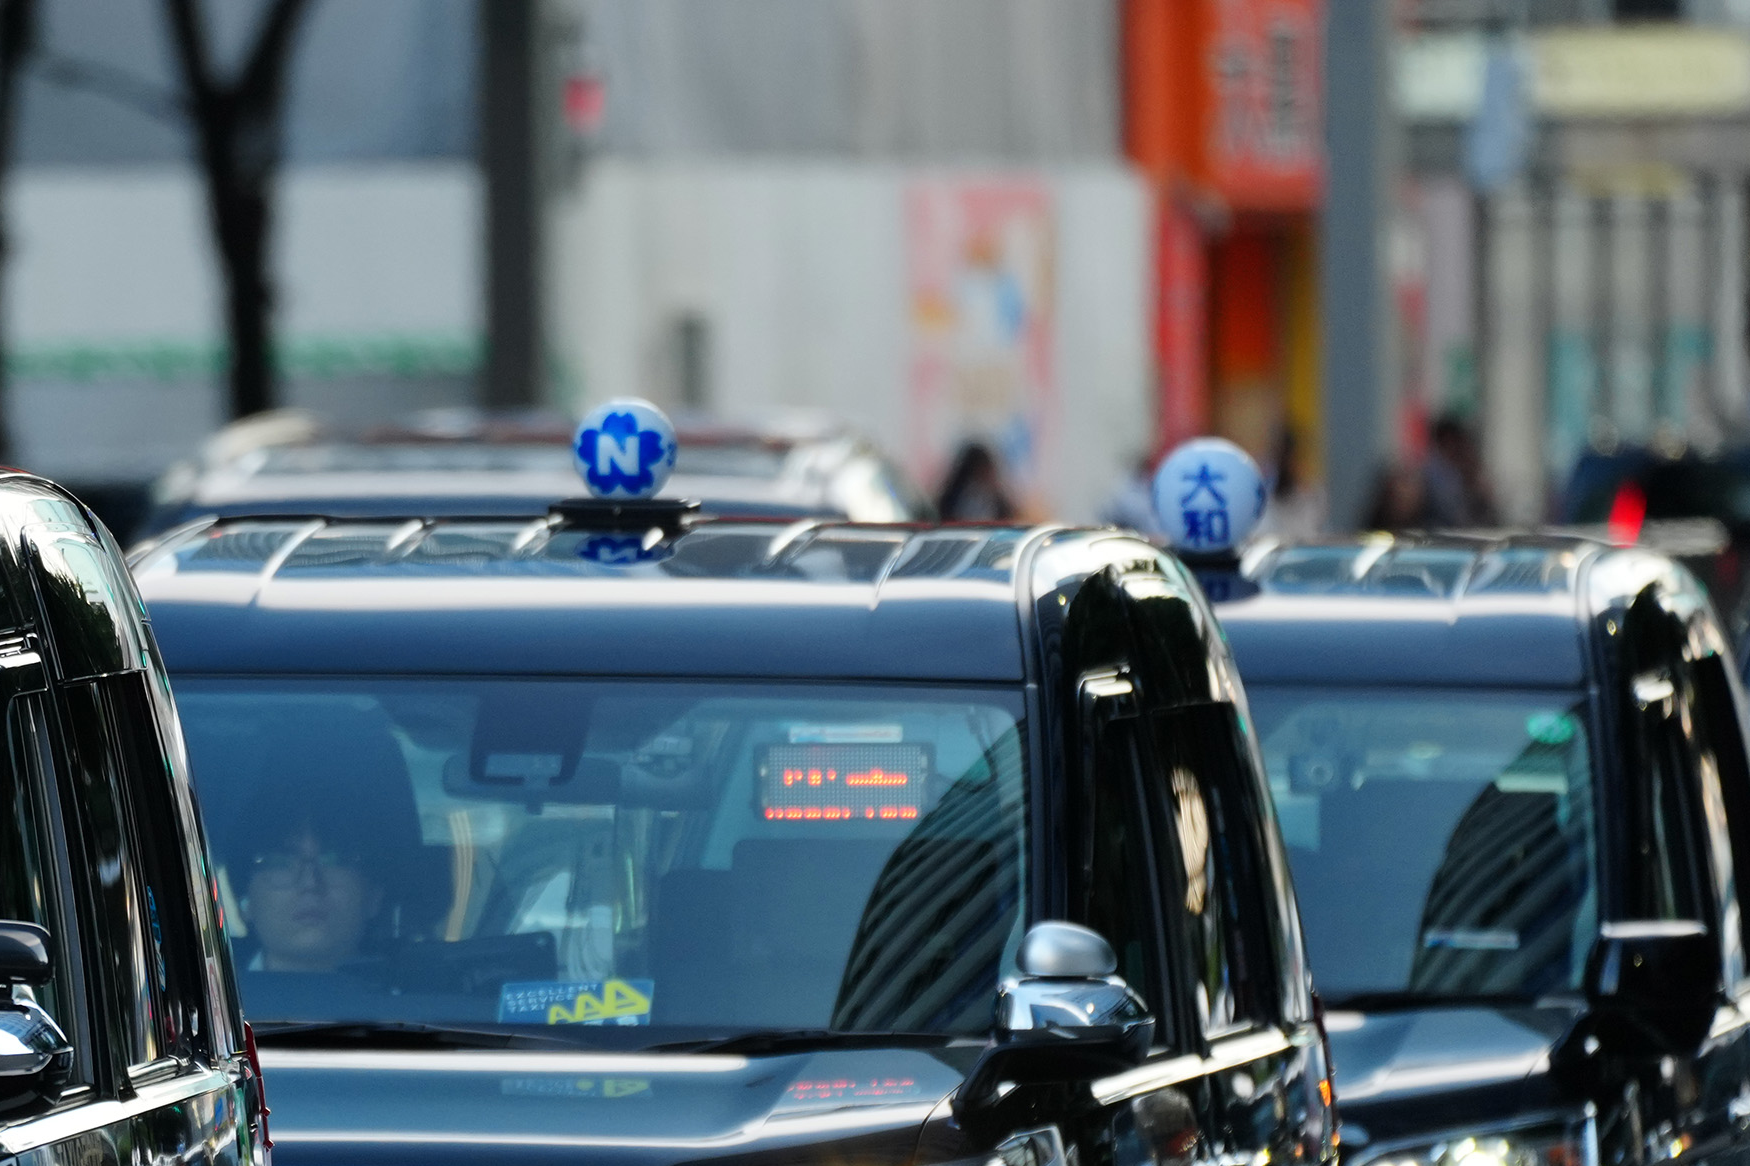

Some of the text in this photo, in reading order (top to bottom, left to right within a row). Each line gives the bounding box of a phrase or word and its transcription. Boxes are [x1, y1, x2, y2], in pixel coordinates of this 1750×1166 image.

[597, 434, 640, 476] N
[1181, 464, 1230, 546] 大和
[505, 983, 598, 1001] EXCELLENT
[507, 993, 576, 1007] SERVICE
